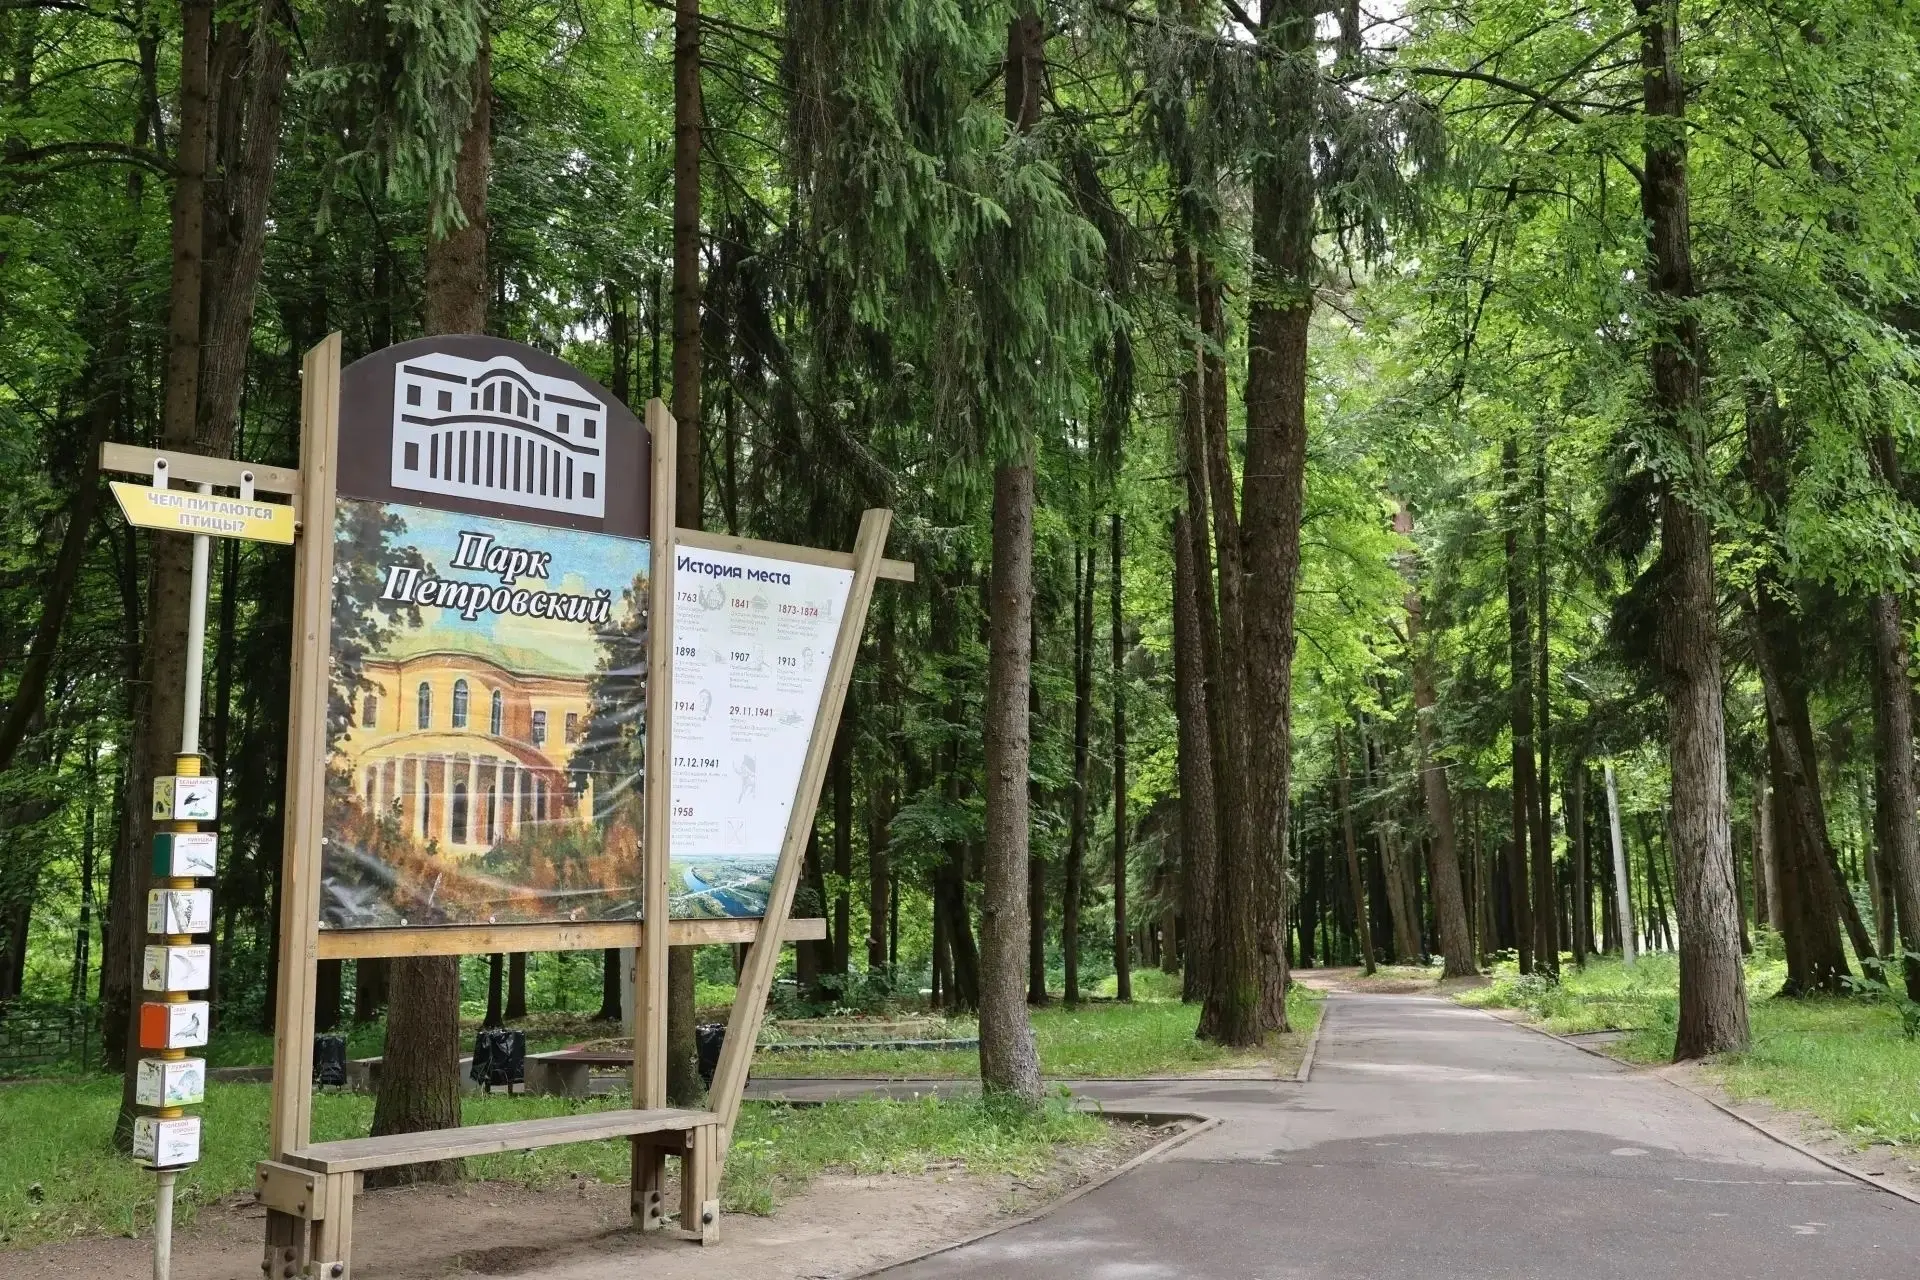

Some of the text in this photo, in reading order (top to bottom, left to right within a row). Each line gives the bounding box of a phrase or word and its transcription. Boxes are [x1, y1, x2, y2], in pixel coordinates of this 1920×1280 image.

[148, 493, 273, 520] ЧЕМ ПИТАЮТСЯ
[179, 514, 246, 532] ПТИЦЫ?
[452, 532, 550, 583] Парк
[677, 556, 791, 585] История места
[379, 565, 611, 623] Петровский
[677, 592, 697, 603] 1763
[731, 598, 749, 609] 1841
[778, 604, 818, 617] 1873-1874
[675, 646, 696, 657] 1898
[730, 652, 750, 662] 1907
[778, 656, 796, 667] 1913
[675, 701, 695, 711] 1914
[729, 706, 773, 717] 29.11.1941
[673, 757, 719, 768] 17.12.1941
[673, 807, 694, 817] 1958
